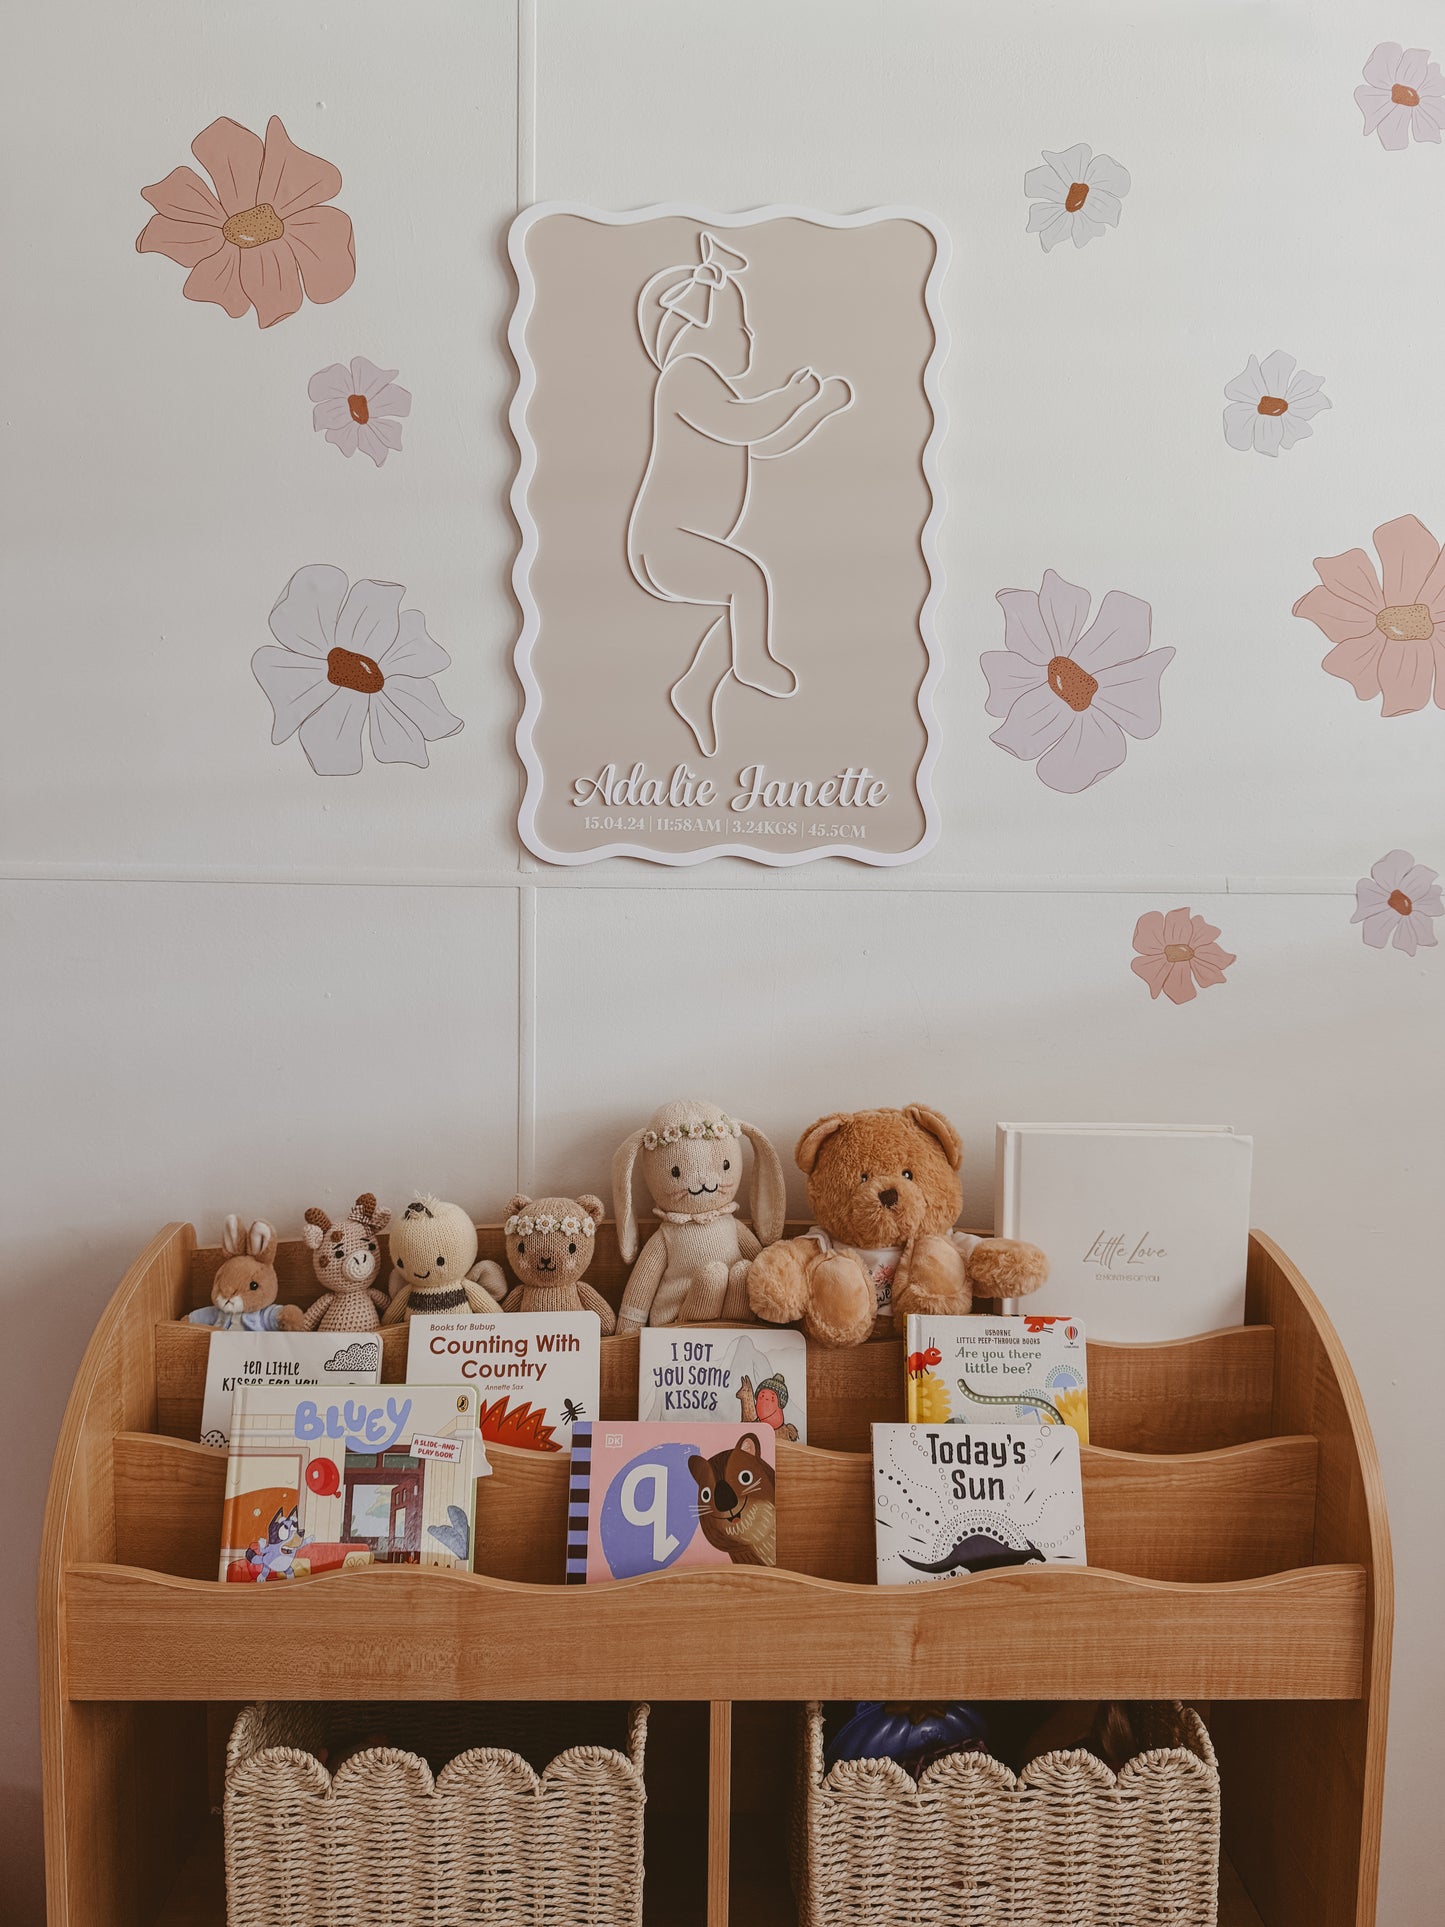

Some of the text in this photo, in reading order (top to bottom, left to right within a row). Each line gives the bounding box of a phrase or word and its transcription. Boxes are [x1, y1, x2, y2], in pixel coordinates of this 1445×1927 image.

[571, 762, 889, 812] Adalie Janette
[584, 817, 866, 839] 15.04.24 11:58AM 3.24KGS 45.5CM
[1083, 1230, 1167, 1270] Little Love
[470, 1323, 496, 1332] Bubup
[429, 1334, 580, 1357] Counting With
[670, 1342, 678, 1361] I
[978, 1337, 1020, 1345] PEEP-THROUGH
[955, 1346, 1042, 1362] Are you there
[461, 1359, 547, 1381] Country
[965, 1362, 1032, 1374] little bee?
[294, 1397, 413, 1454] BLUEY
[418, 1448, 434, 1456] PLAY
[607, 1437, 622, 1446] DK
[926, 1433, 1026, 1468] Today's
[951, 1469, 1005, 1501] Sun
